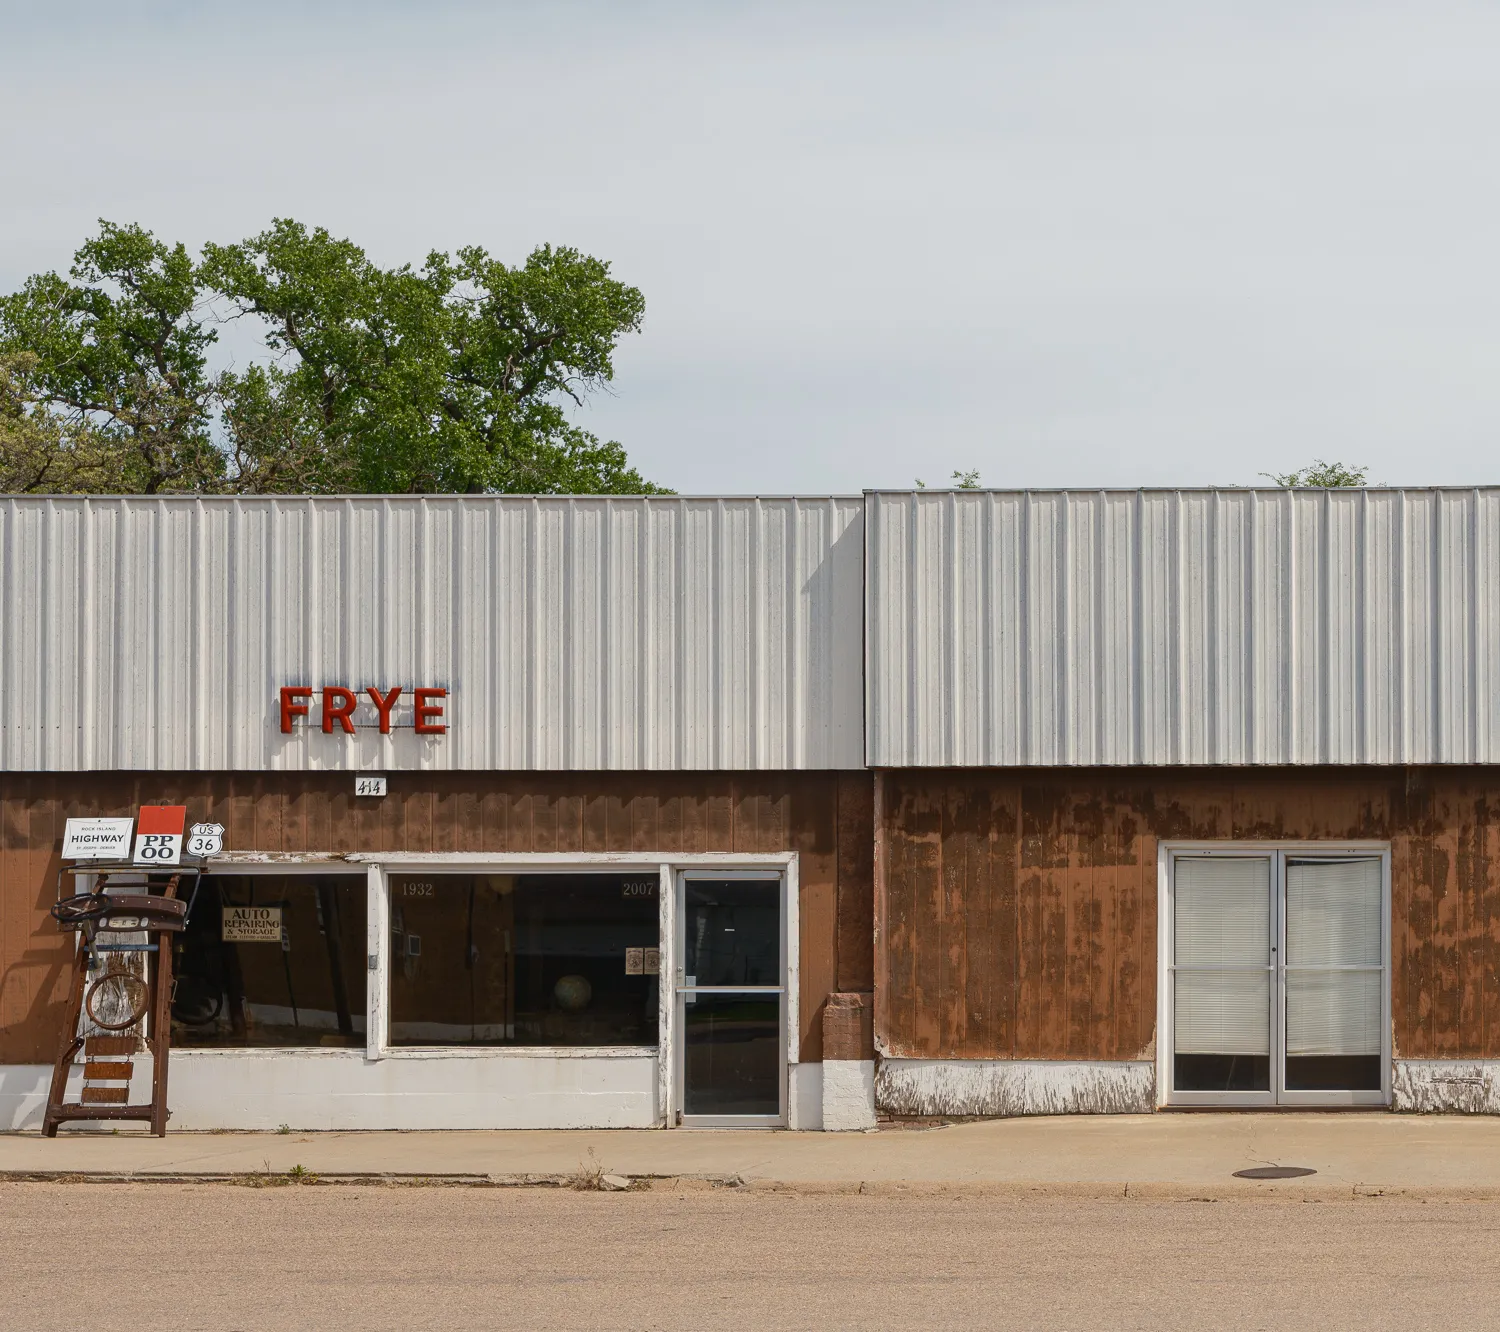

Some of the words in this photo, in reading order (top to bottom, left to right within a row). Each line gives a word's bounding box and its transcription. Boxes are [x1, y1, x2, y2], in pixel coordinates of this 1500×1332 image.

[280, 686, 446, 734] FRYE
[357, 780, 380, 794] 414
[199, 827, 214, 835] US
[71, 834, 124, 843] HIGHWAY
[143, 835, 174, 846] PP
[194, 838, 214, 851] 36
[403, 882, 433, 896] 1932
[623, 882, 654, 896] 2007
[232, 909, 270, 920] AUTO
[224, 920, 279, 928] REPAIRING
